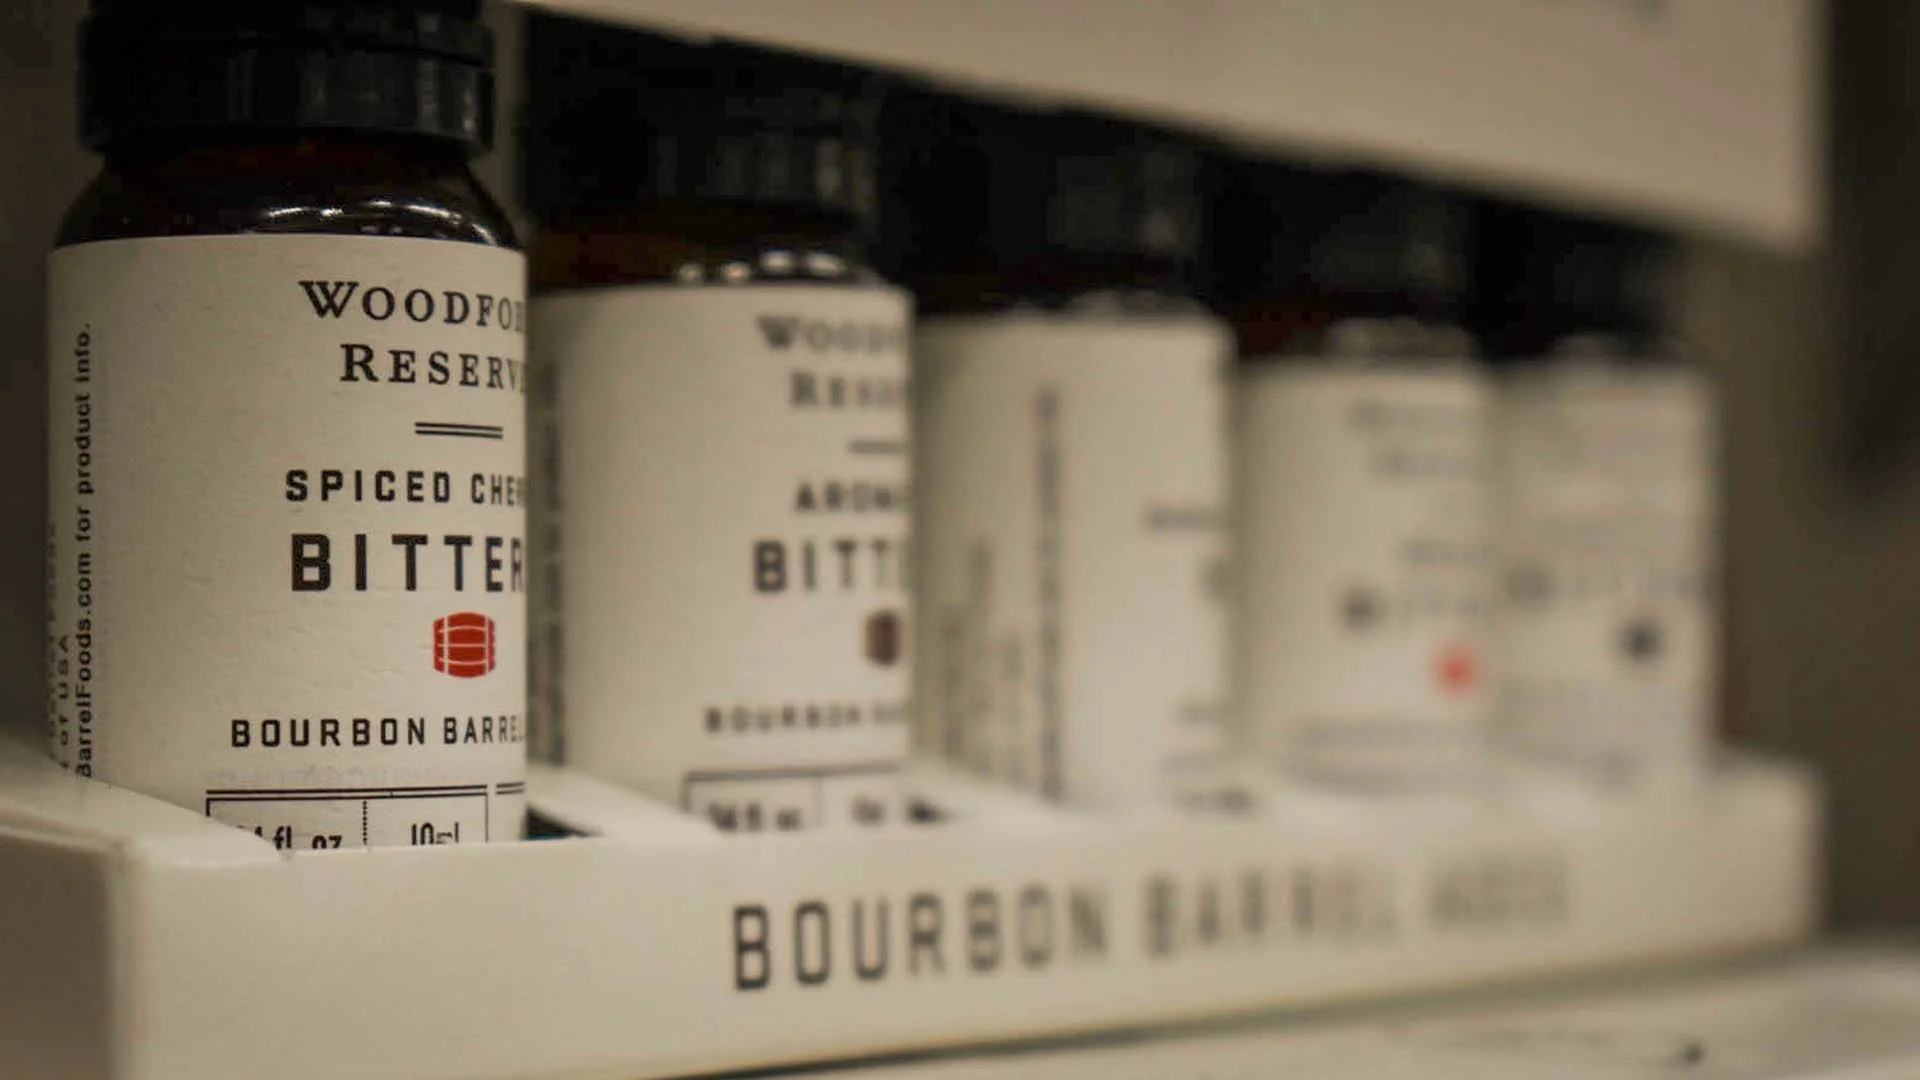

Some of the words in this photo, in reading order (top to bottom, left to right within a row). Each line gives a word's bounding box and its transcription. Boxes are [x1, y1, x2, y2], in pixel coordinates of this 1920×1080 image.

[73, 322, 91, 382] info.
[74, 391, 95, 495] product
[285, 469, 449, 502] SPICED
[75, 507, 91, 541] for
[231, 717, 426, 748] BOURBON
[734, 884, 1108, 992] BOURBON
